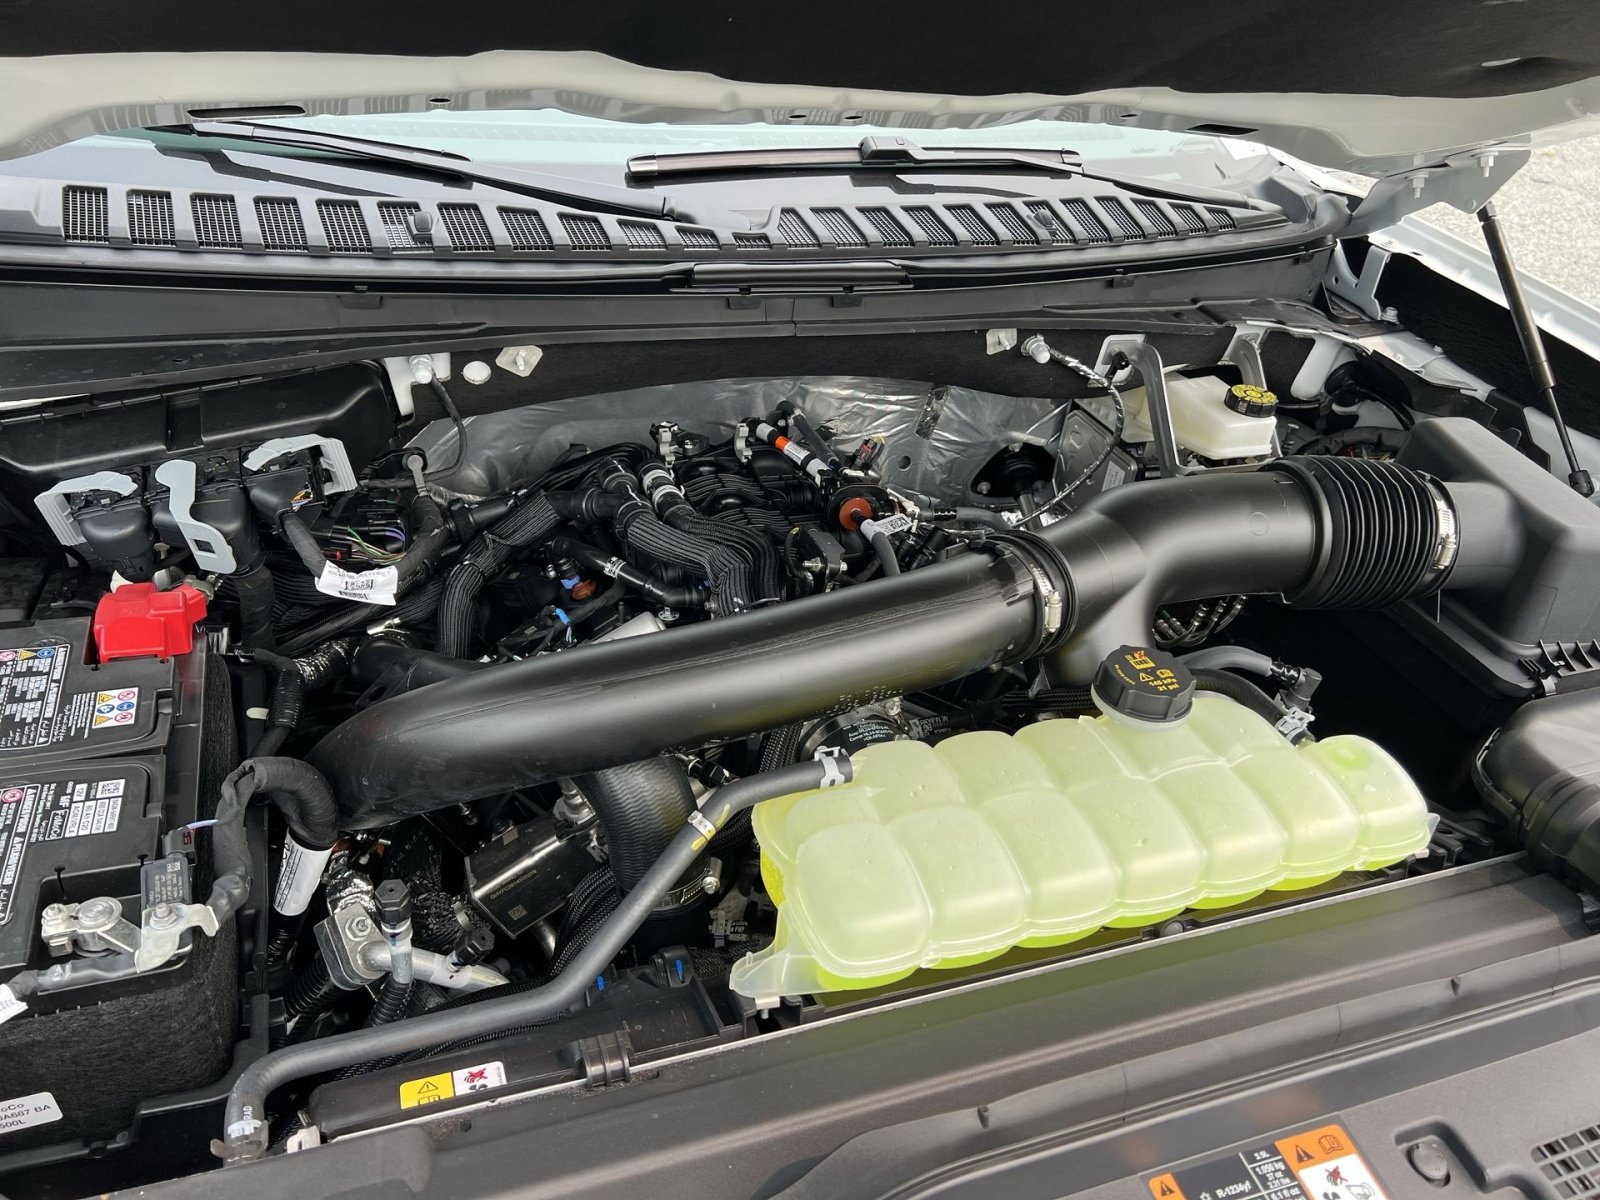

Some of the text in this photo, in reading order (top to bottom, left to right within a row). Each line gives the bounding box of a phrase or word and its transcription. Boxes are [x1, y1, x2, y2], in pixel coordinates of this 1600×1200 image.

[59, 795, 71, 808] MF
[49, 811, 65, 839] FoMoCo
[0, 1103, 24, 1112] oCo
[34, 1104, 51, 1113] BA
[243, 1105, 252, 1120] RAD
[1215, 1180, 1252, 1199] R-1234yf
